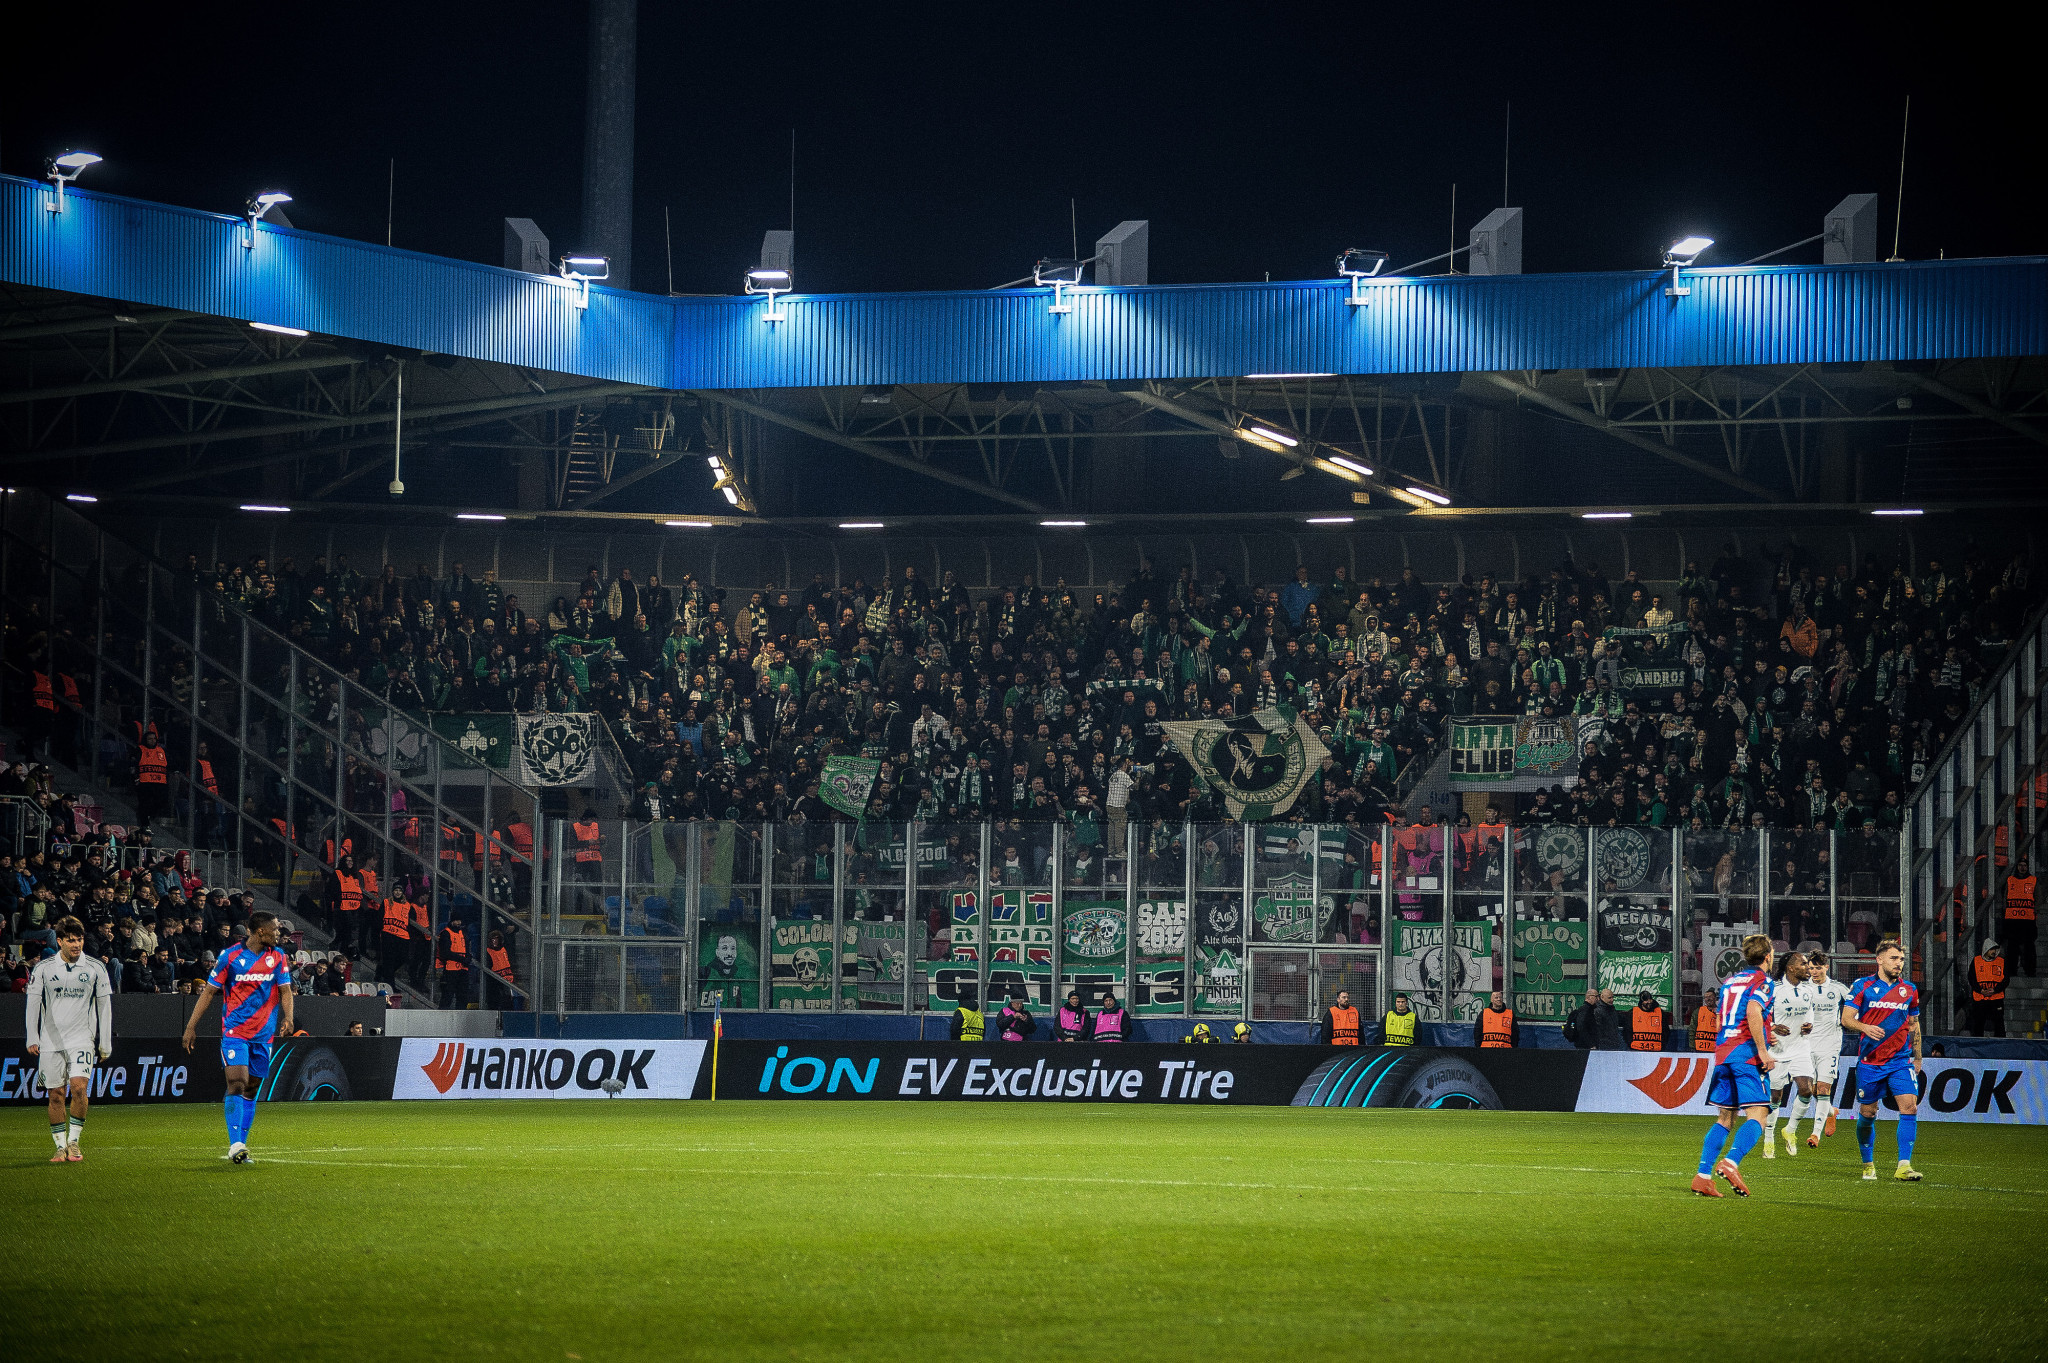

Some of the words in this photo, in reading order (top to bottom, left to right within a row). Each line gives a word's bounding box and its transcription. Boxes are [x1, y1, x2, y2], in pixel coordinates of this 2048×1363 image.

[1635, 671, 1686, 685] ANDROS
[1604, 911, 1672, 931] MEGARA
[1513, 924, 1584, 950] VOLOS
[1516, 994, 1554, 1016] GATE
[1722, 985, 1747, 1026] 17
[1640, 1042, 1655, 1050] 343
[77, 1050, 92, 1065] 20
[1831, 1056, 1837, 1067] 3
[0, 1056, 127, 1099] Excive
[138, 1055, 188, 1097] Tire
[898, 1058, 957, 1096] EV
[961, 1058, 1144, 1098] Exclusive
[1157, 1060, 1235, 1100] Tire
